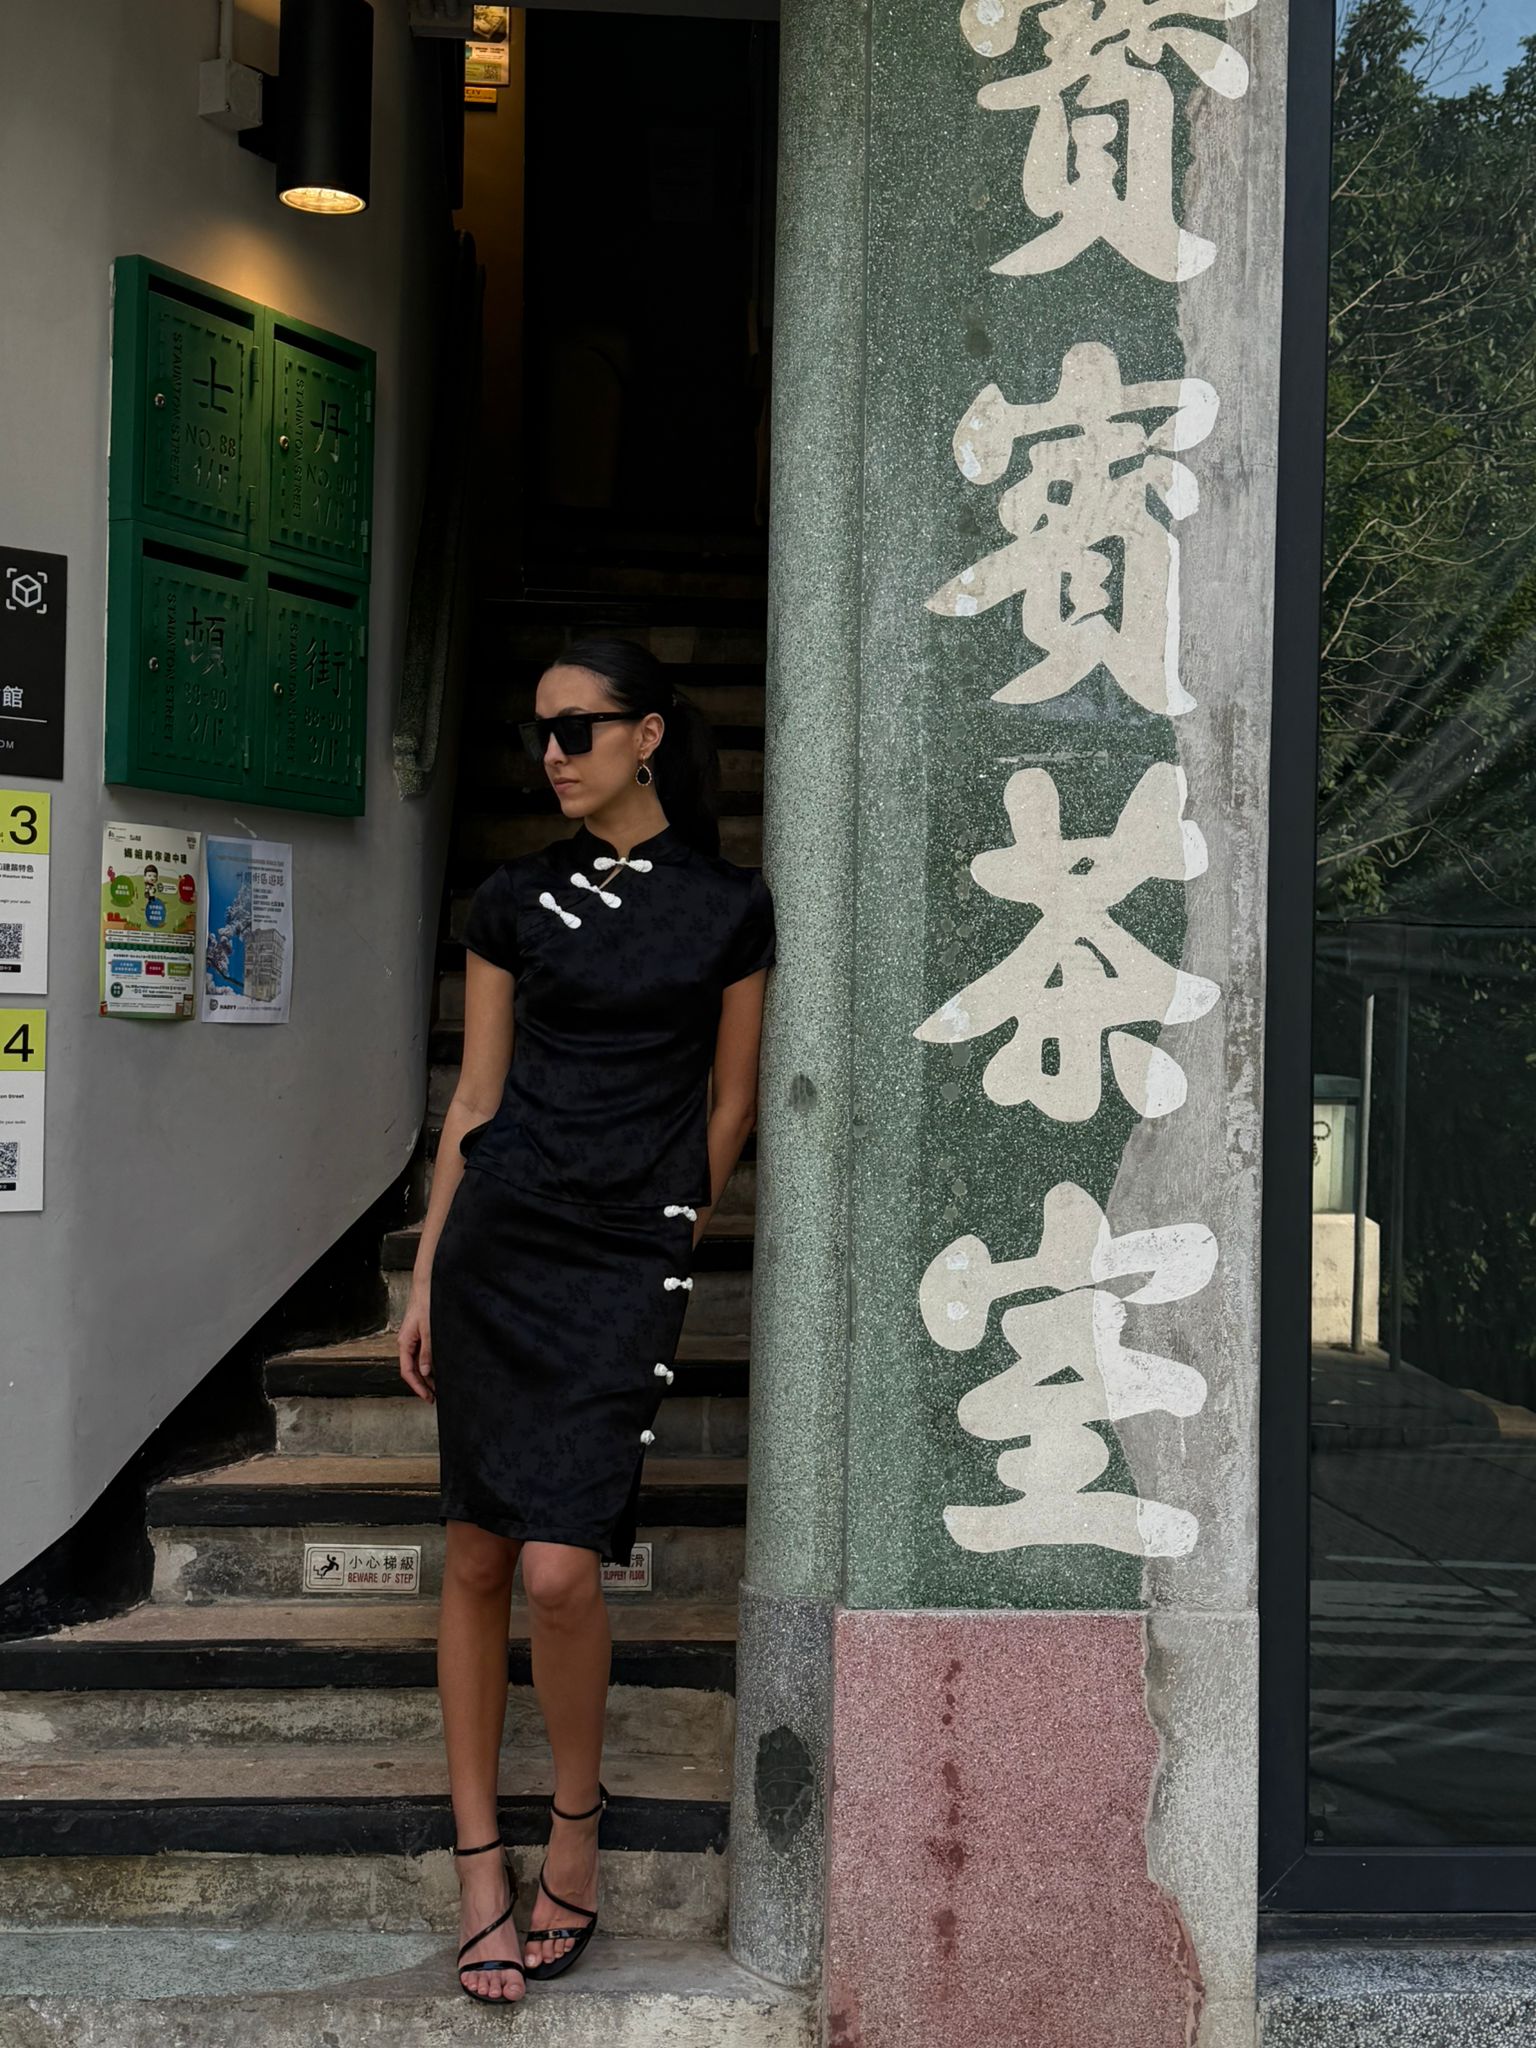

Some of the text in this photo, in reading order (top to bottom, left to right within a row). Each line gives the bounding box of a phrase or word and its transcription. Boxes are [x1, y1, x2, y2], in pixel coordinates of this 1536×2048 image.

[191, 355, 235, 415] 士
[310, 399, 350, 464] 丹
[193, 455, 230, 494] 1/F
[184, 605, 229, 679] 頓
[304, 636, 346, 699] 街
[187, 712, 225, 747] 2/F
[308, 735, 340, 768] 3/F
[9, 805, 38, 845] 3
[3, 1023, 35, 1062] 4
[347, 1572, 414, 1584] BEWARE OF STEP
[348, 1555, 414, 1570] 小心梯級
